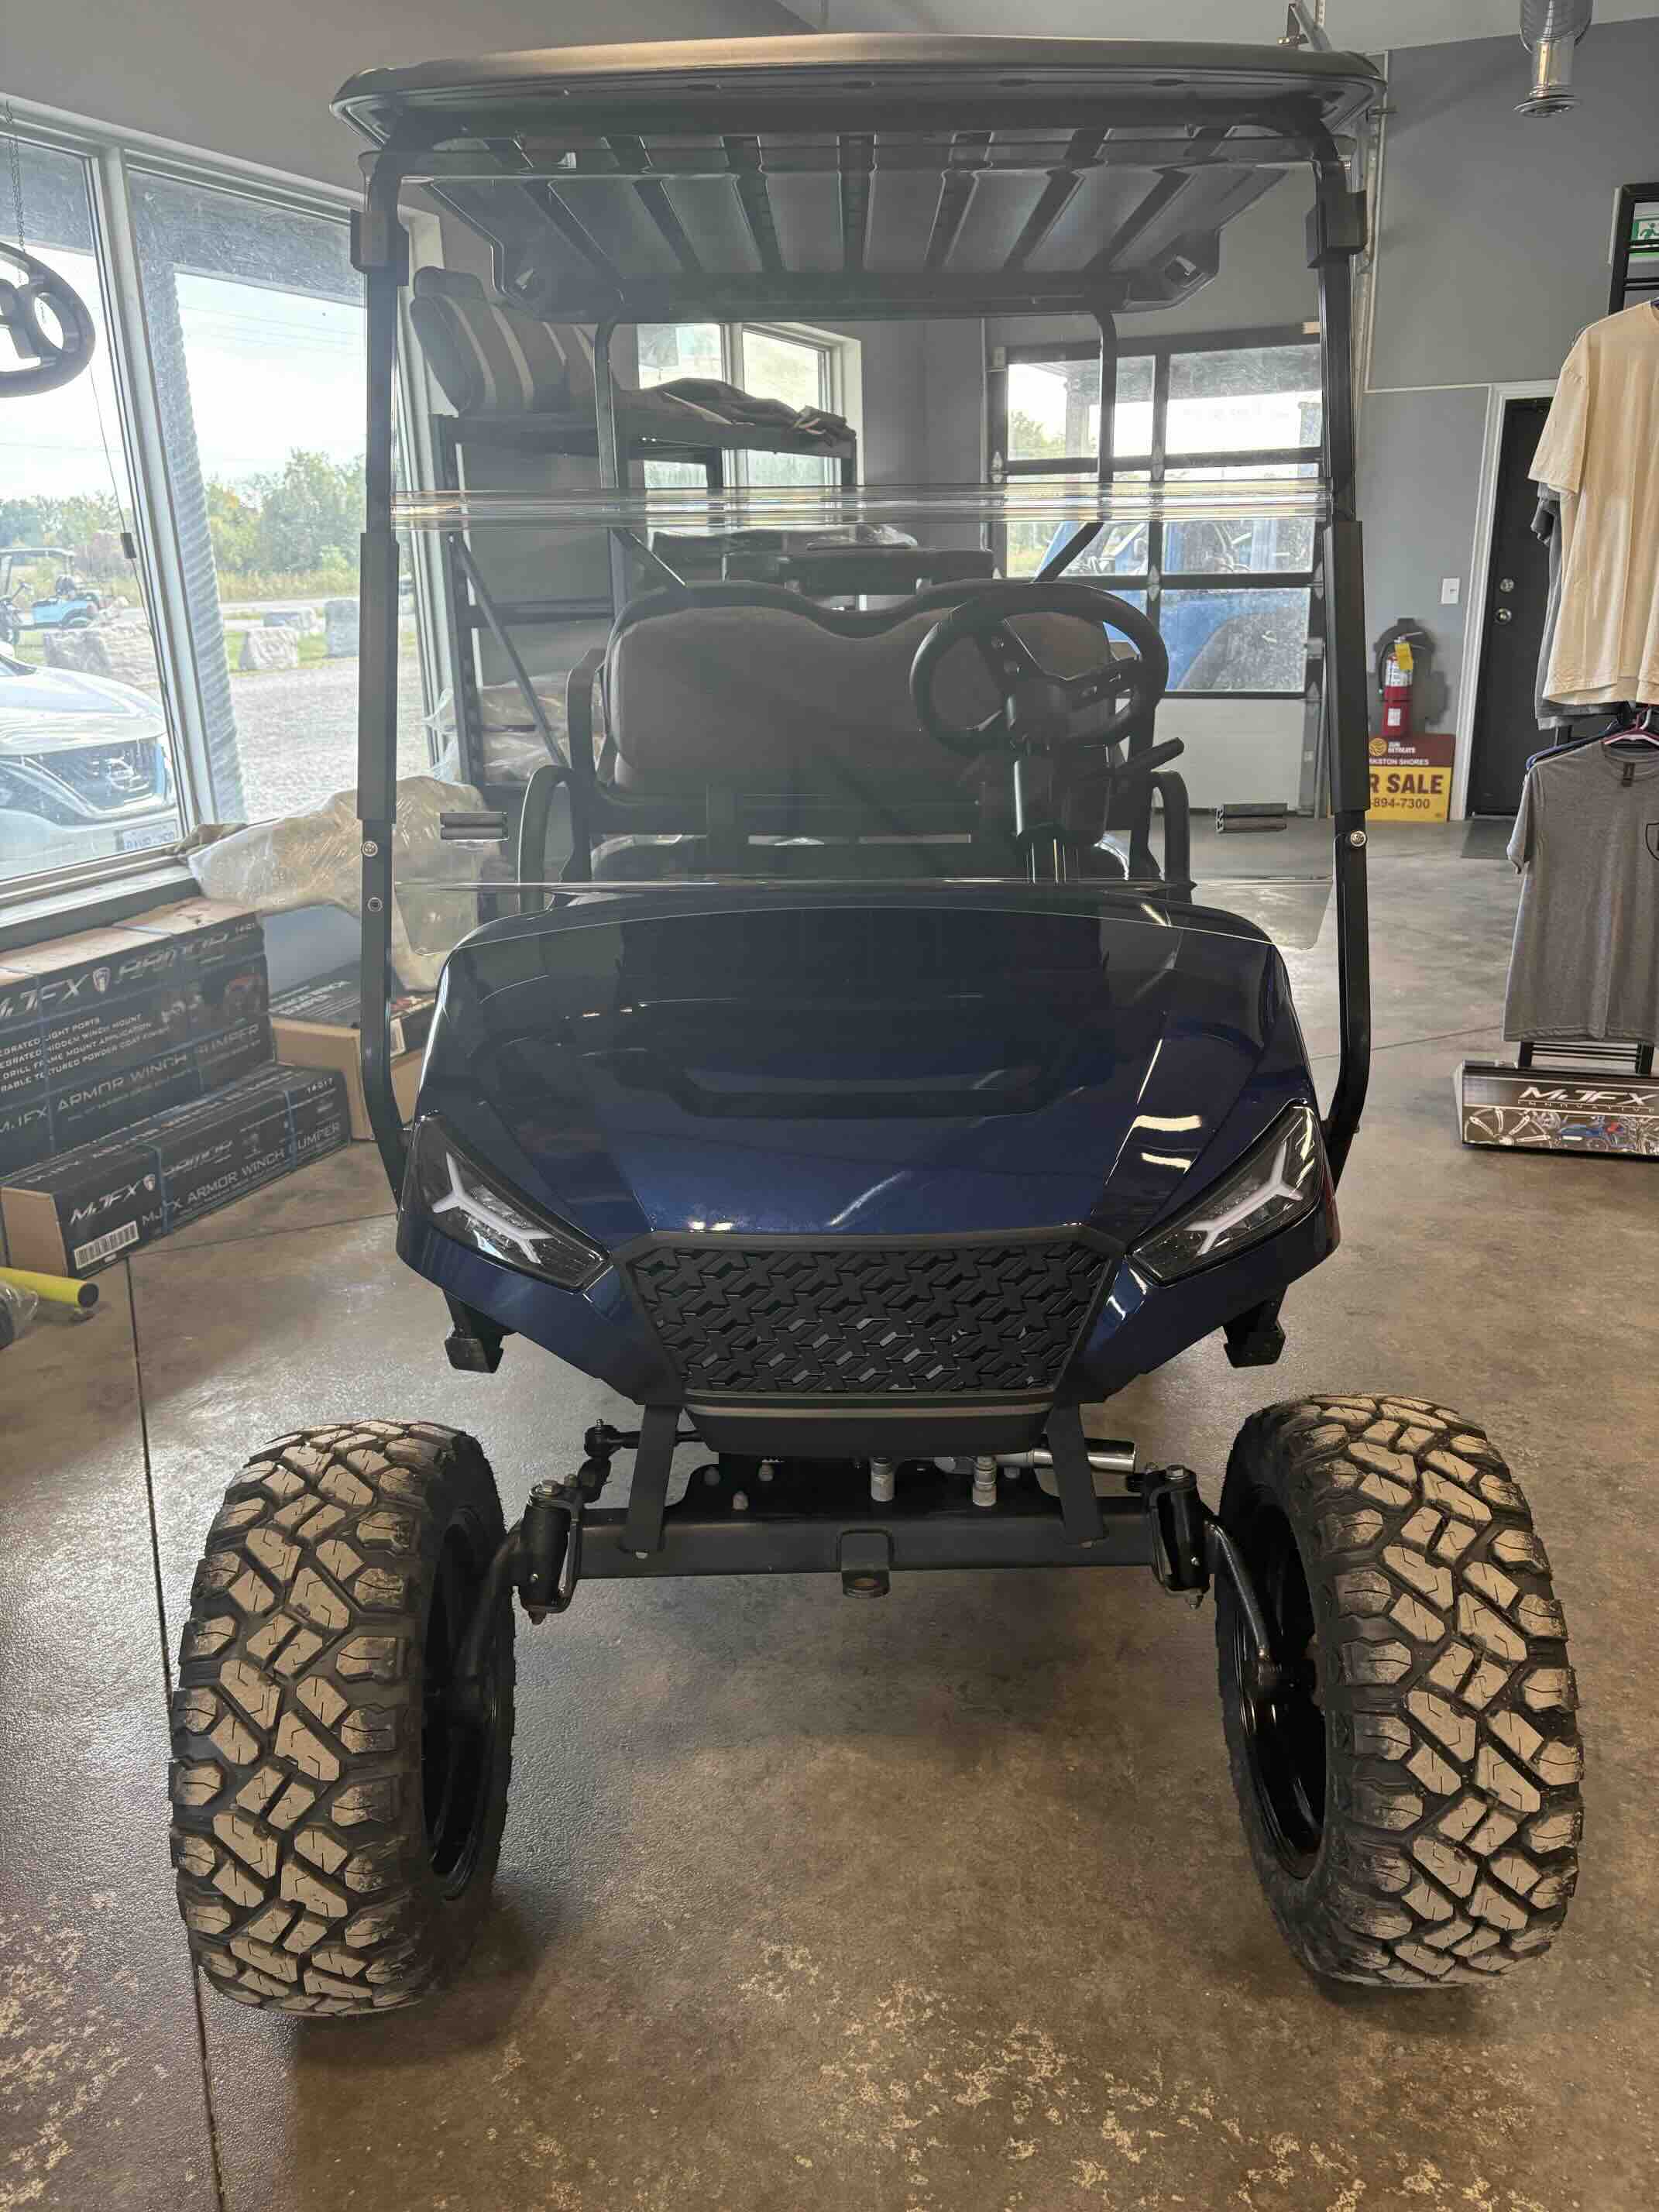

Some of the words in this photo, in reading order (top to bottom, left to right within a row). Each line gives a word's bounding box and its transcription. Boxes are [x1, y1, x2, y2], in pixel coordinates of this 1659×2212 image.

[1386, 773, 1444, 794] SALE
[3, 1065, 31, 1080] DRILL
[58, 1077, 124, 1111] ARMOR
[187, 1171, 238, 1204] ARMOR
[242, 1149, 286, 1176] WINCH
